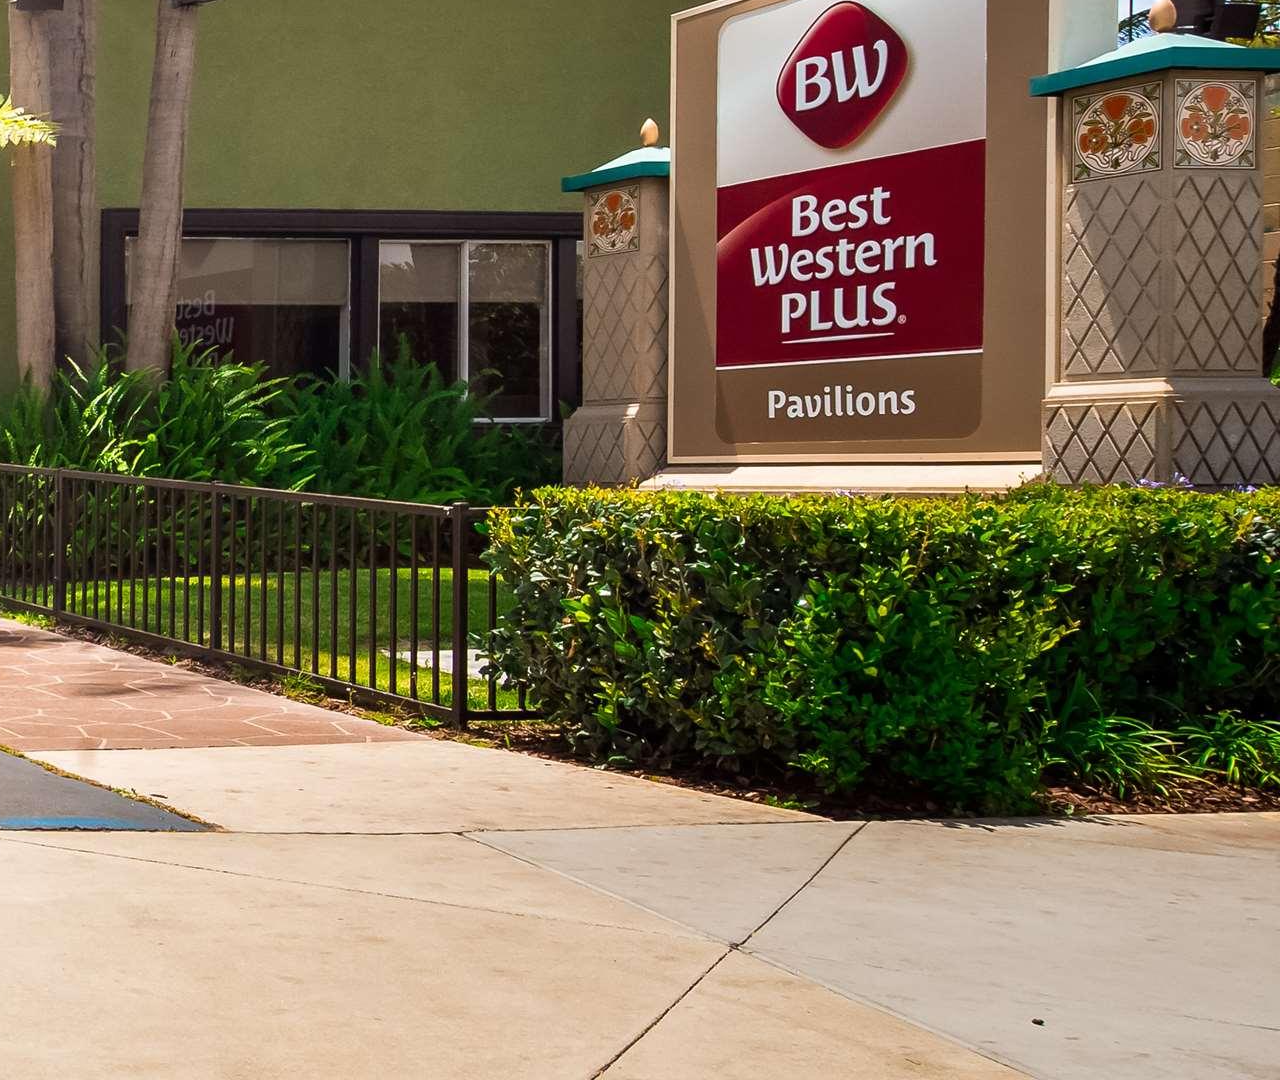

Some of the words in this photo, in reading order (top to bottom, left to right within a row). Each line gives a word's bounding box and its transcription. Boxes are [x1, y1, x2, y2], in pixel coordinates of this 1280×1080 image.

[795, 39, 888, 112] BW
[791, 186, 892, 237] Best
[750, 232, 938, 287] Western
[768, 385, 916, 418] Pavilions
